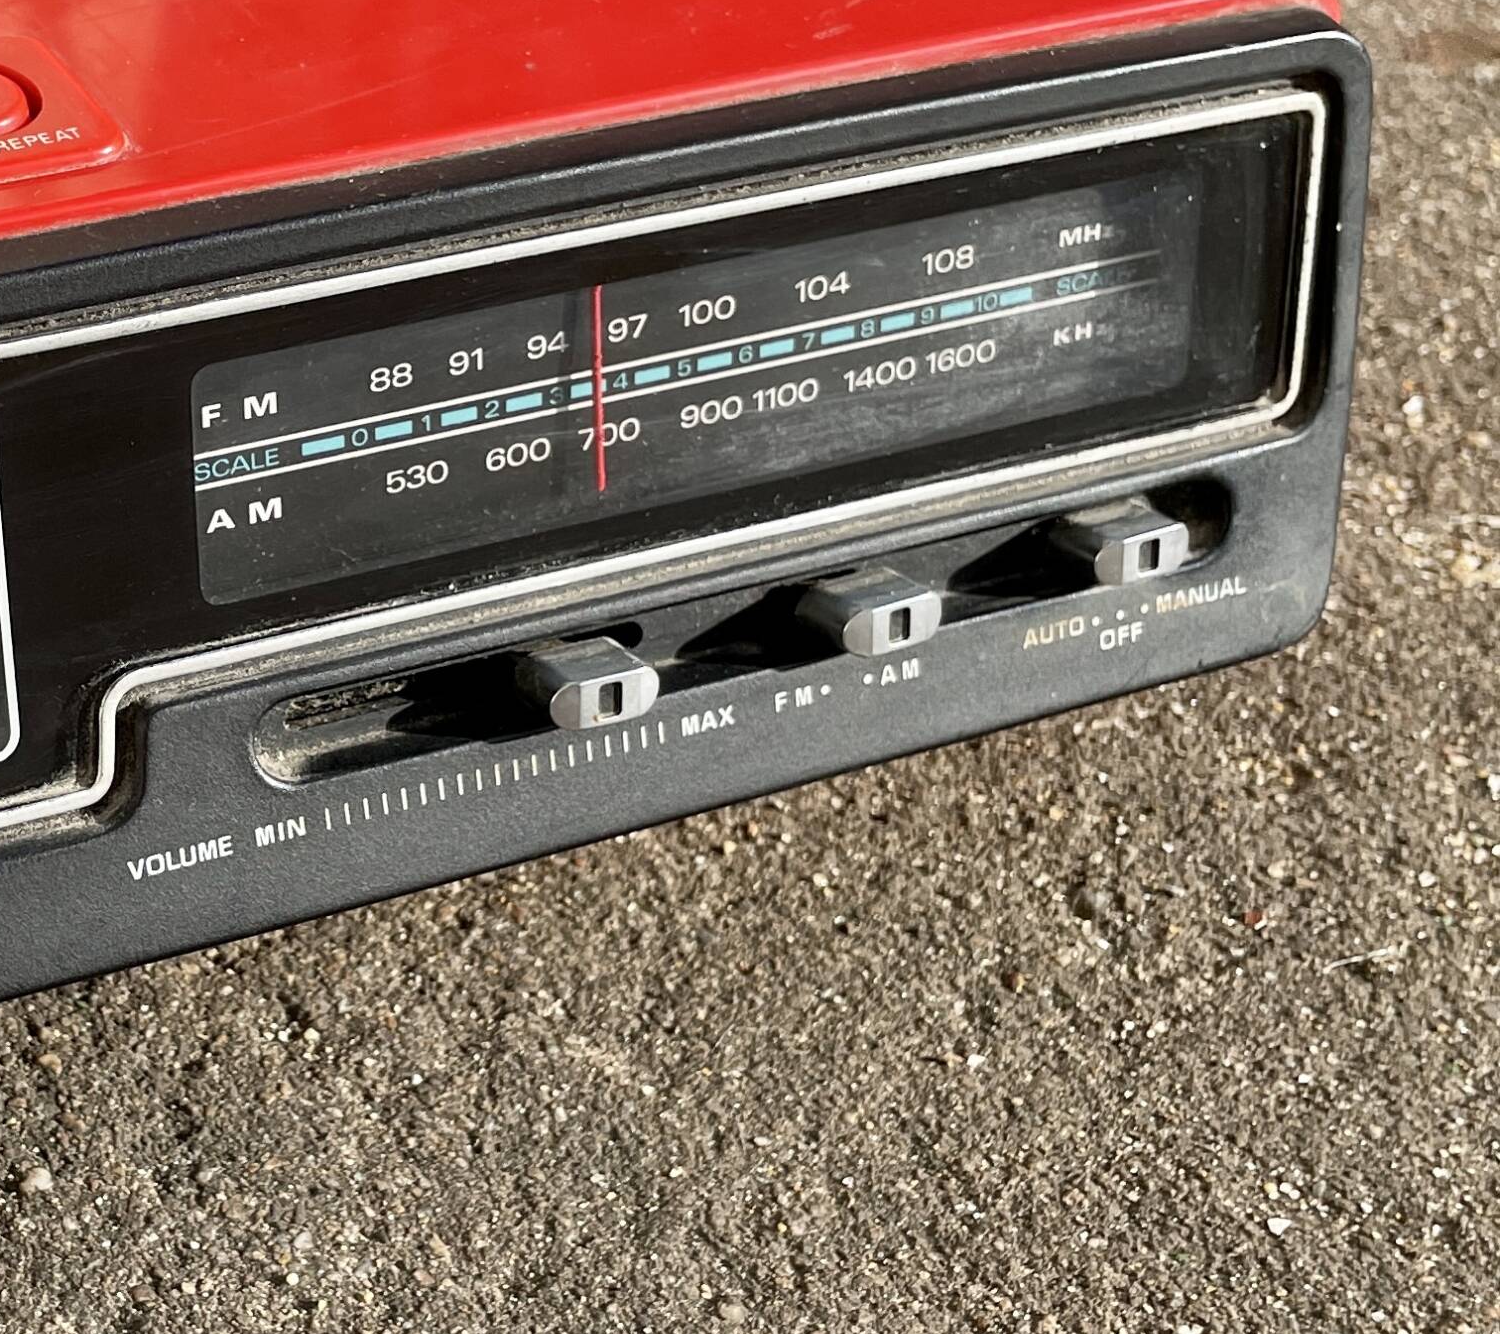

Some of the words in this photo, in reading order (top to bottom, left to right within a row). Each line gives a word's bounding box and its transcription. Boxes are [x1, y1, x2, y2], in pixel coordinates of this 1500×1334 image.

[369, 363, 413, 393] 88
[449, 348, 485, 376] 91
[526, 331, 569, 360] 94
[607, 313, 649, 343] 97
[678, 295, 736, 327] 100
[794, 271, 851, 303] 104
[921, 245, 975, 276] 108
[194, 448, 281, 482] SCALE
[351, 428, 369, 447] 0
[420, 415, 431, 433] 1
[484, 400, 500, 419] 2
[548, 387, 565, 405] 3
[612, 372, 629, 389] 4
[676, 359, 692, 377] 5
[738, 346, 753, 364] 6
[802, 332, 816, 351] 7
[860, 320, 876, 338] 8
[920, 307, 935, 325] 9
[976, 294, 999, 313] 10
[386, 460, 449, 494] 530
[485, 438, 551, 472] 600
[579, 417, 641, 451] 700
[680, 395, 742, 429] 900
[752, 378, 819, 412] 1100
[844, 356, 917, 393] 1400
[926, 339, 997, 374] 1600
[1155, 575, 1247, 614] MANUAL
[1022, 615, 1086, 650] AUTO
[1100, 621, 1144, 652] OFF
[880, 658, 920, 687] AM
[774, 685, 813, 713] FM
[127, 835, 234, 881] VOLUME
[255, 815, 307, 848] MIN
[681, 705, 735, 737] MAX
